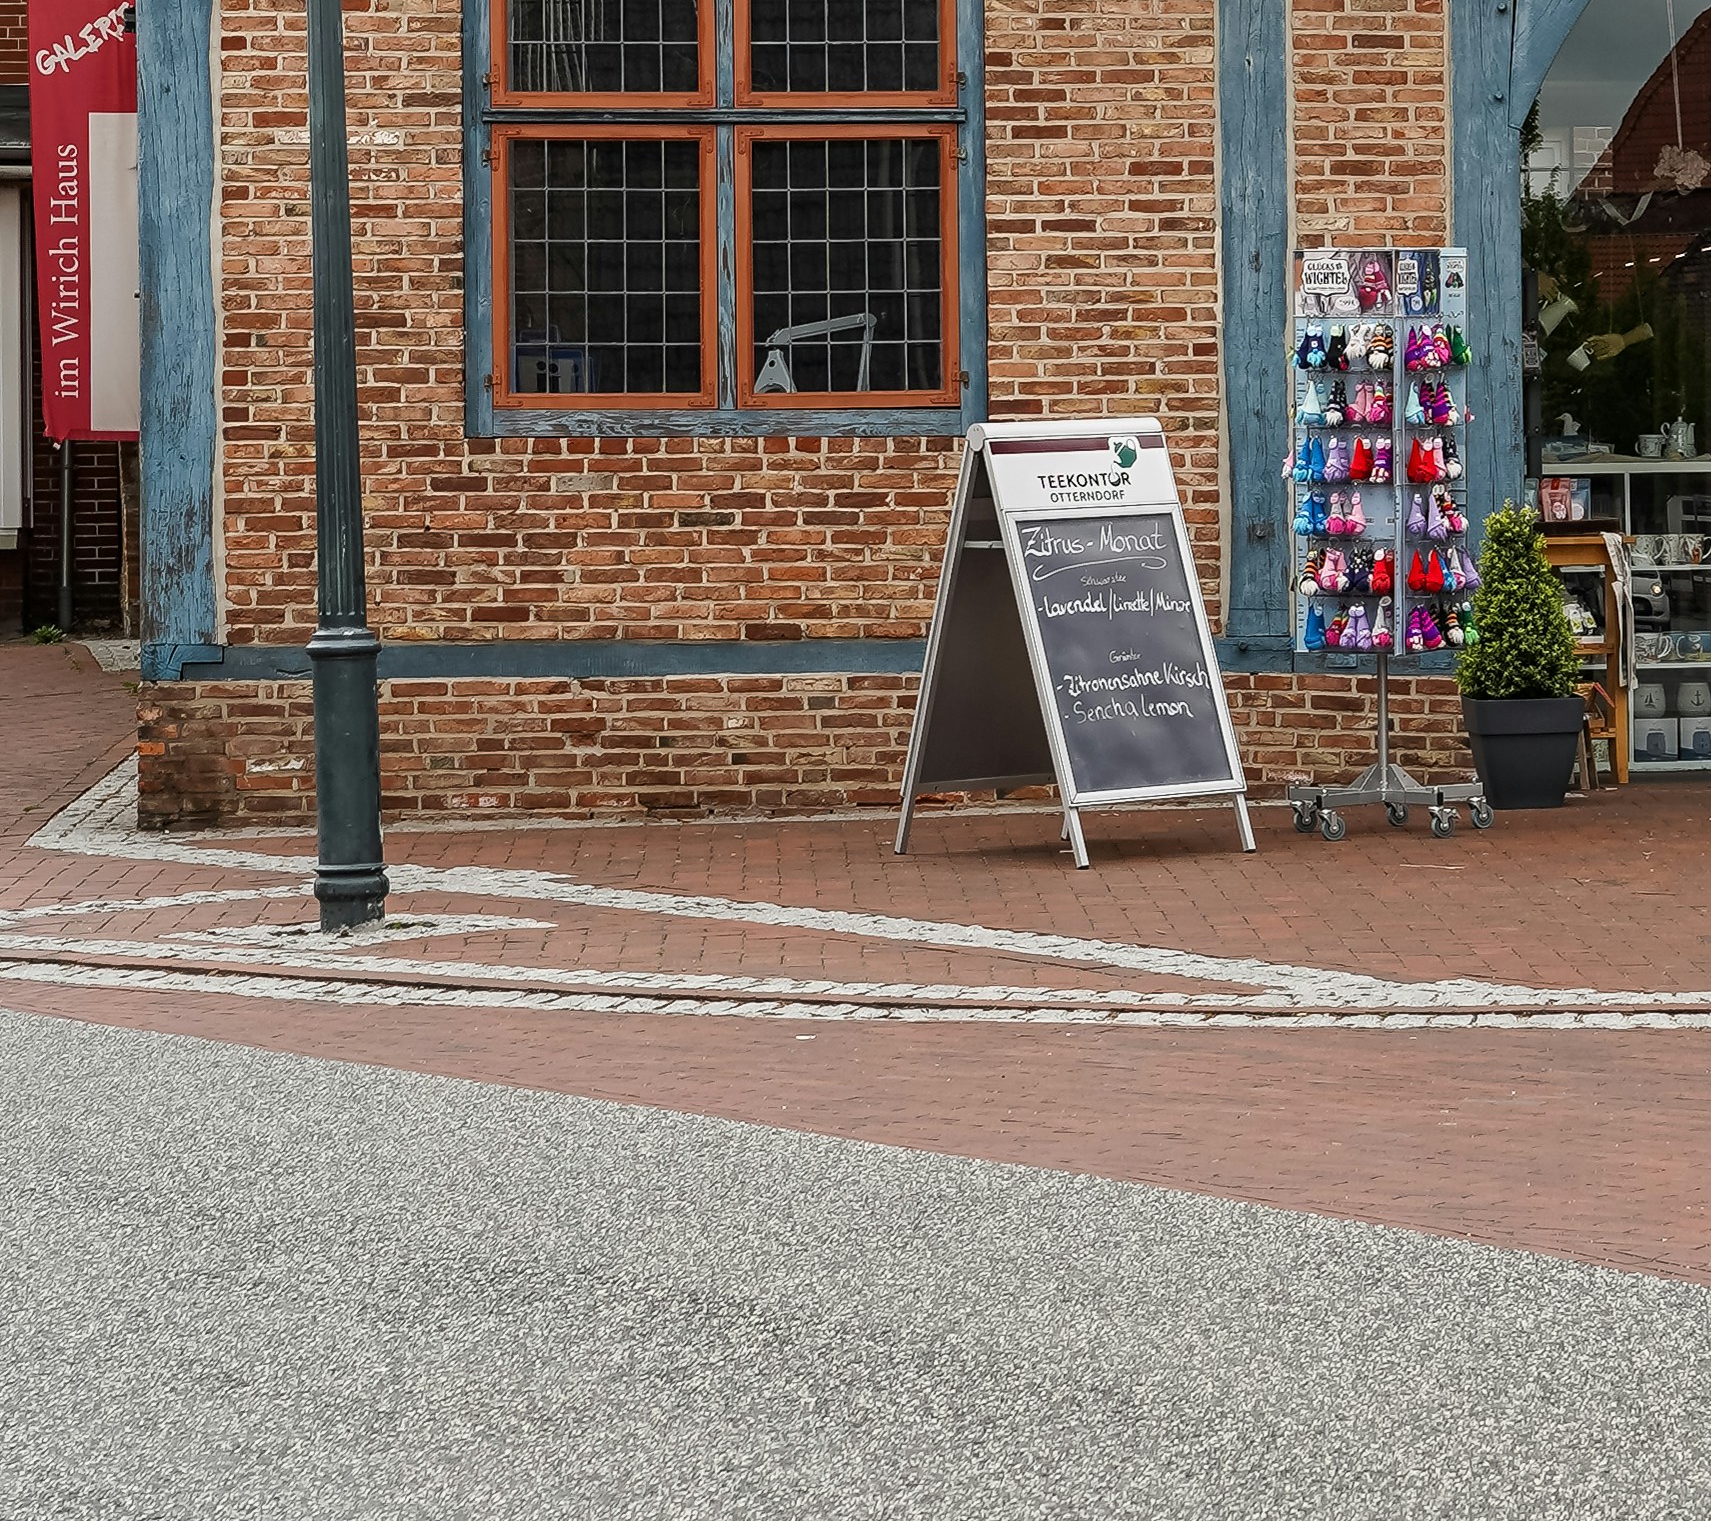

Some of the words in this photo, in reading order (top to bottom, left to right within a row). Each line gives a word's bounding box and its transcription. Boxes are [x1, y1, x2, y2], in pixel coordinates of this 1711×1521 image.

[50, 144, 79, 226] Haus
[48, 236, 80, 347] Wirich
[54, 356, 79, 399] im
[1037, 471, 1132, 489] TEEKONTOR
[1049, 489, 1126, 503] OTTERNDORF
[1099, 522, 1168, 553] Monat
